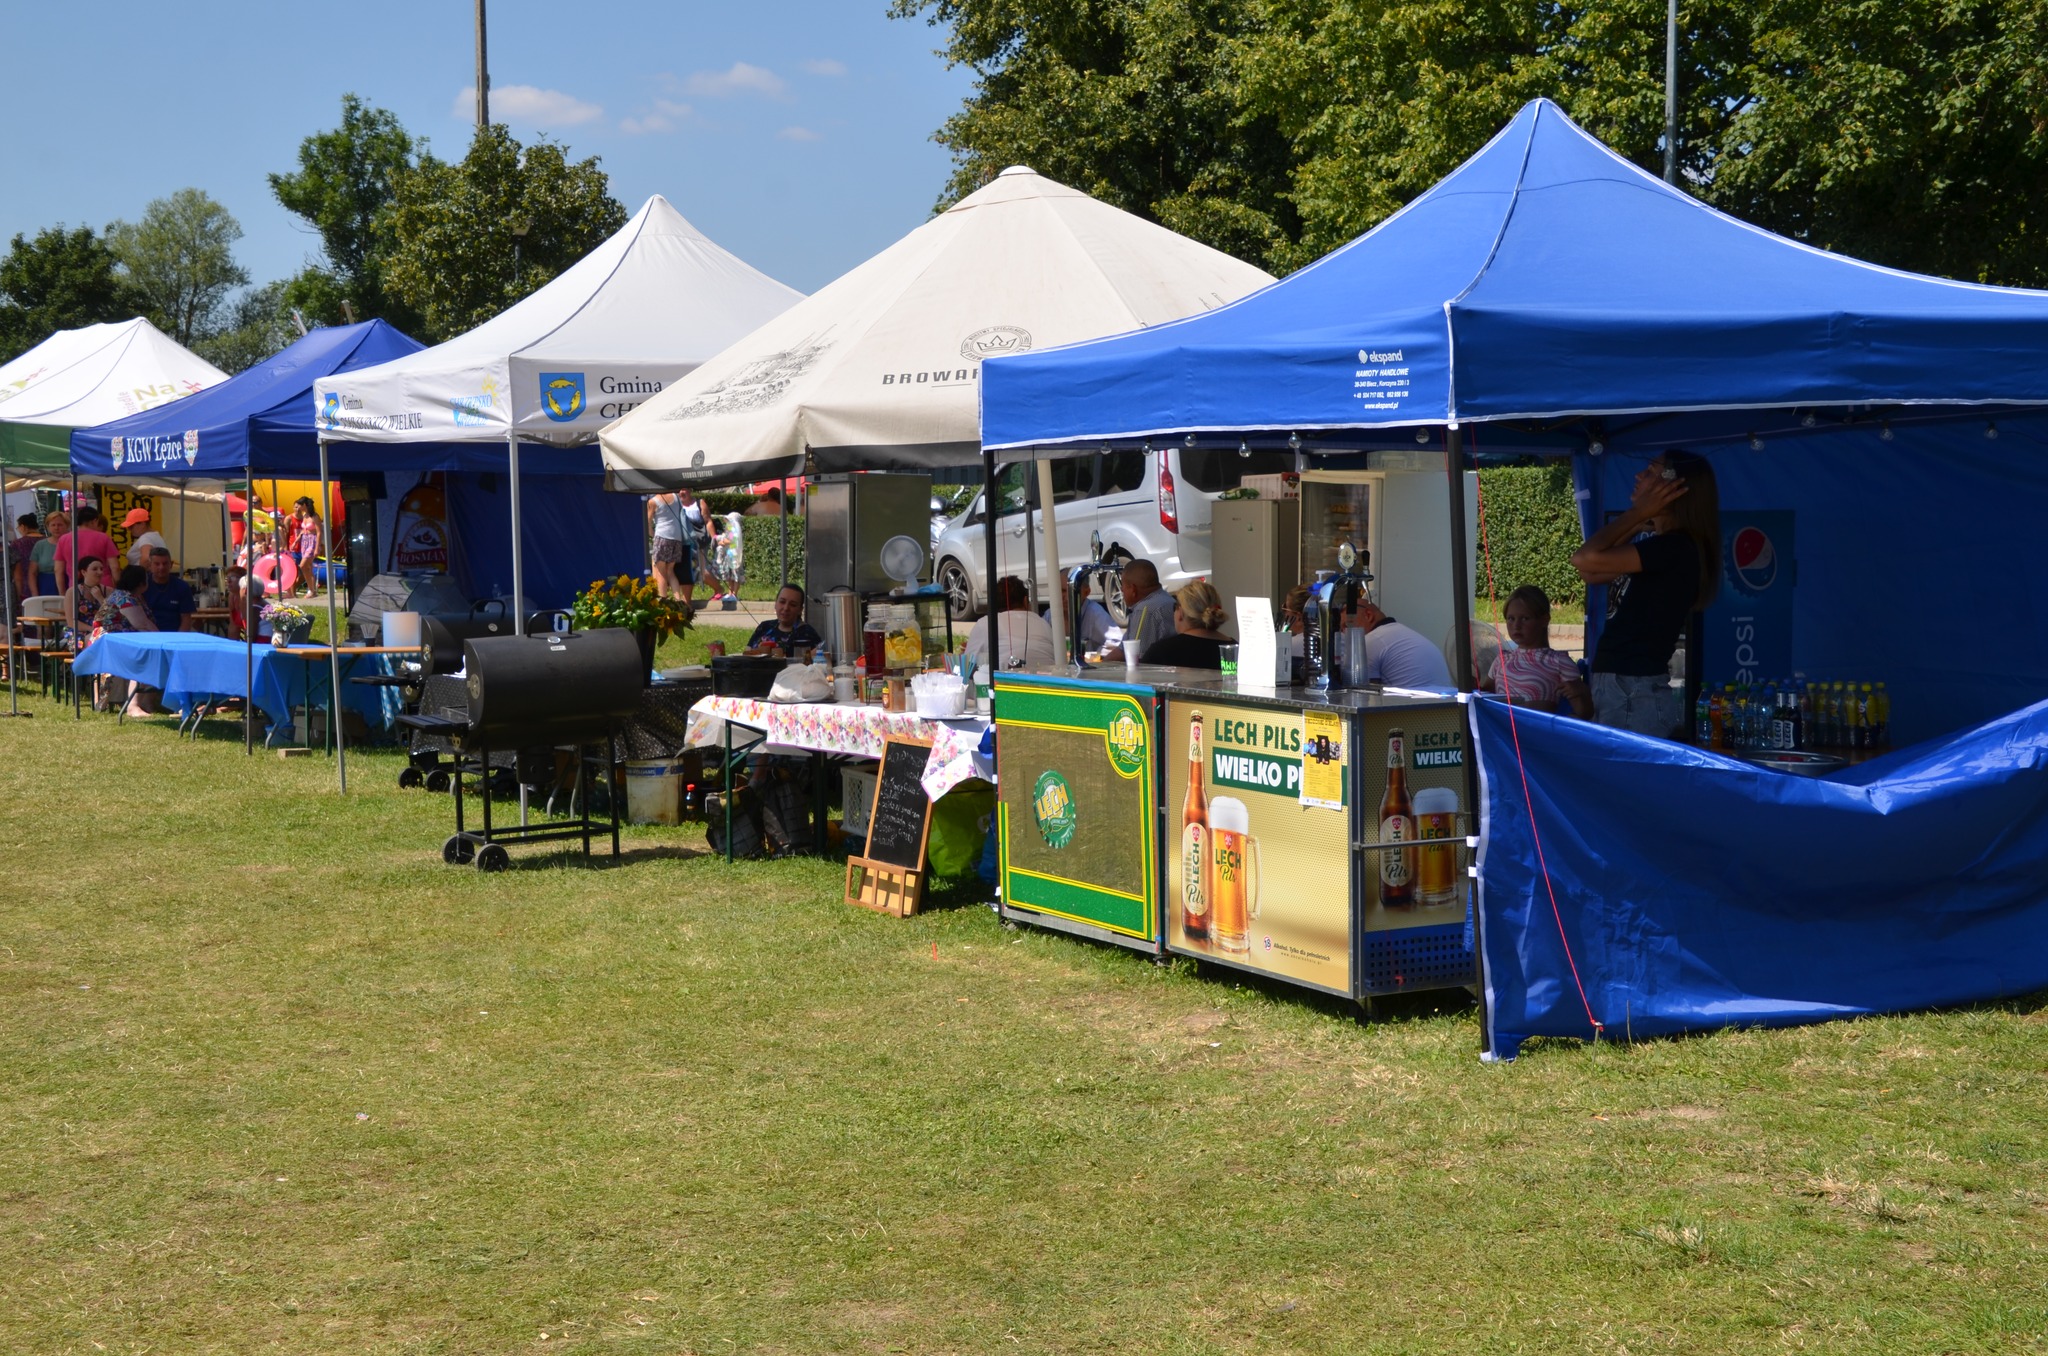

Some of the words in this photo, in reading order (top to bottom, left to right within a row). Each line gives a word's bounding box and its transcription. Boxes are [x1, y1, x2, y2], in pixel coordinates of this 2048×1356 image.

[1369, 349, 1403, 365] ekspand
[1355, 369, 1379, 377] NAMIOTY
[1379, 368, 1409, 377] HANDLOWE
[132, 382, 177, 401] Na
[600, 376, 662, 394] Gmina
[342, 395, 363, 411] Gmina
[600, 402, 641, 419] CH
[1364, 401, 1399, 410] www.ekspand.pl
[388, 413, 423, 430] WIELKIE
[127, 438, 151, 463] KGW
[155, 436, 182, 468] Łężce
[399, 551, 447, 565] BOSMAN
[1732, 616, 1759, 687] epsi
[1109, 721, 1144, 746] LECH
[1215, 719, 1257, 746] LECH
[1264, 725, 1301, 752] PILS
[1415, 732, 1449, 747] LECH
[1774, 721, 1782, 744] LECH
[1784, 721, 1792, 744] LECH
[1215, 754, 1282, 787] WIELKO
[1036, 783, 1069, 820] LECH
[1421, 828, 1451, 841] LECH
[1392, 830, 1402, 863] LEH
[1192, 843, 1200, 884] LECH
[1215, 848, 1242, 869] LECH
[1220, 865, 1236, 882] Pils
[1385, 863, 1408, 881] Pils
[1186, 884, 1206, 905] Pils
[1264, 938, 1272, 948] 18
[1289, 946, 1299, 954] Tylko
